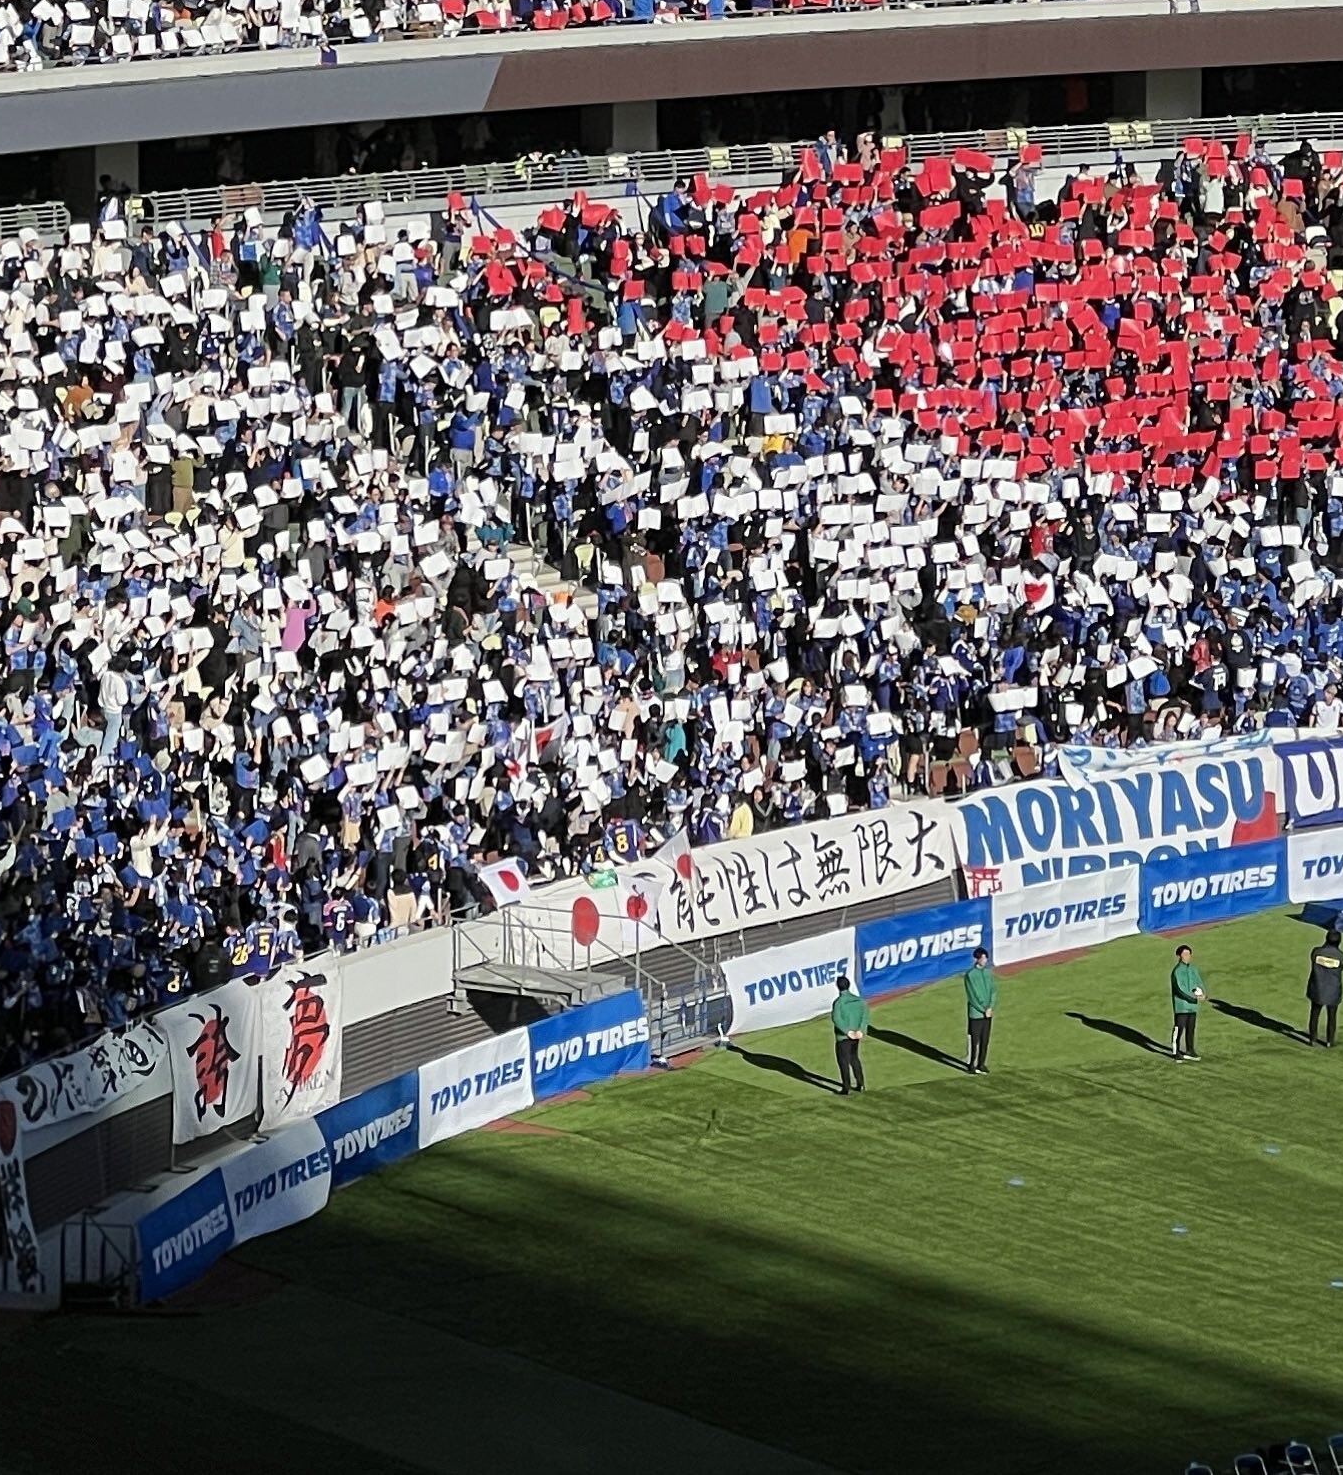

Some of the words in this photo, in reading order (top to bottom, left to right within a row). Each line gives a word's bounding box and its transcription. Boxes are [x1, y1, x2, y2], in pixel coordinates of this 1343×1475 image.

[958, 756, 1266, 869] MORIYASU
[616, 833, 629, 854] 8
[1151, 881, 1208, 909] TOYO
[1206, 864, 1278, 896] TIRES
[337, 912, 345, 932] 6
[1004, 906, 1065, 938] TOYO
[1063, 893, 1127, 925] TIRES
[259, 934, 270, 956] 5
[863, 938, 918, 973] TOYO
[919, 926, 983, 958] TIRES
[744, 970, 803, 1006] TOYO
[801, 957, 849, 990] TIRES
[534, 1035, 584, 1075] TOYO
[584, 1016, 649, 1057] TIRES
[430, 1077, 473, 1116] TOYO
[473, 1057, 526, 1096] TIRES
[234, 1172, 277, 1218] TOYO
[277, 1146, 331, 1192] TIRES
[152, 1227, 195, 1275] TOYO
